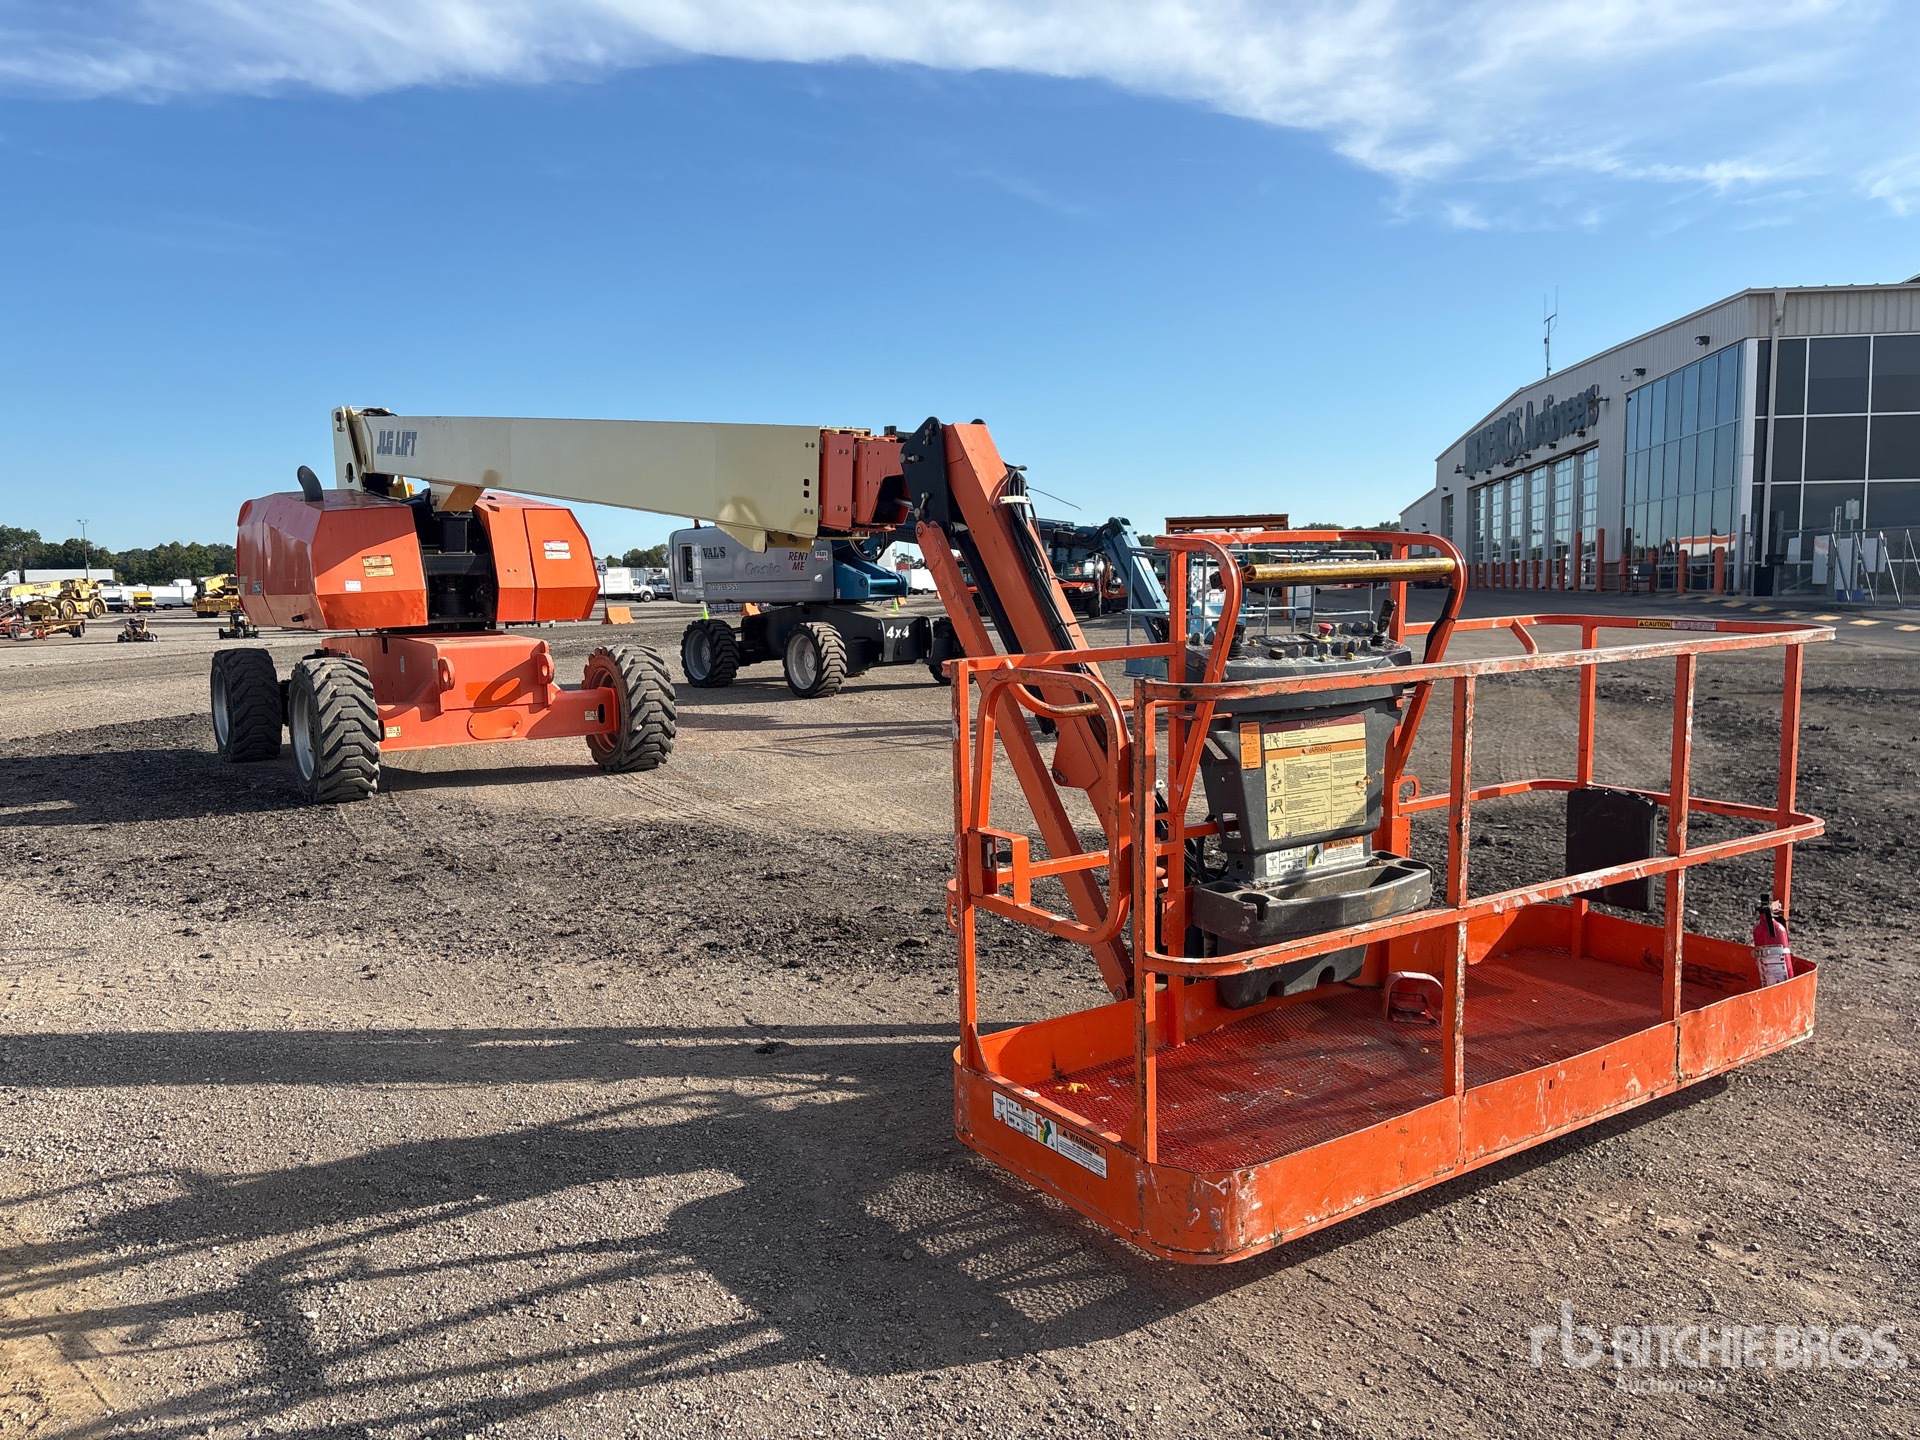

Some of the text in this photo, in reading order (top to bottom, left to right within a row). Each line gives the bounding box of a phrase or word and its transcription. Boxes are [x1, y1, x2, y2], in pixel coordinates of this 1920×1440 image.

[377, 430, 418, 457] JLG LIFT
[703, 547, 726, 559] VAL'S
[788, 551, 809, 561] RENT
[597, 564, 606, 572] 43
[744, 562, 782, 578] Genie
[792, 561, 805, 571] ME
[1644, 620, 1671, 628] CAUTION
[886, 625, 910, 639] 4x4
[1304, 719, 1329, 728] DANGER
[1306, 744, 1333, 755] WARNING
[1333, 837, 1359, 848] WARNING
[1069, 1131, 1100, 1155] WARNING
